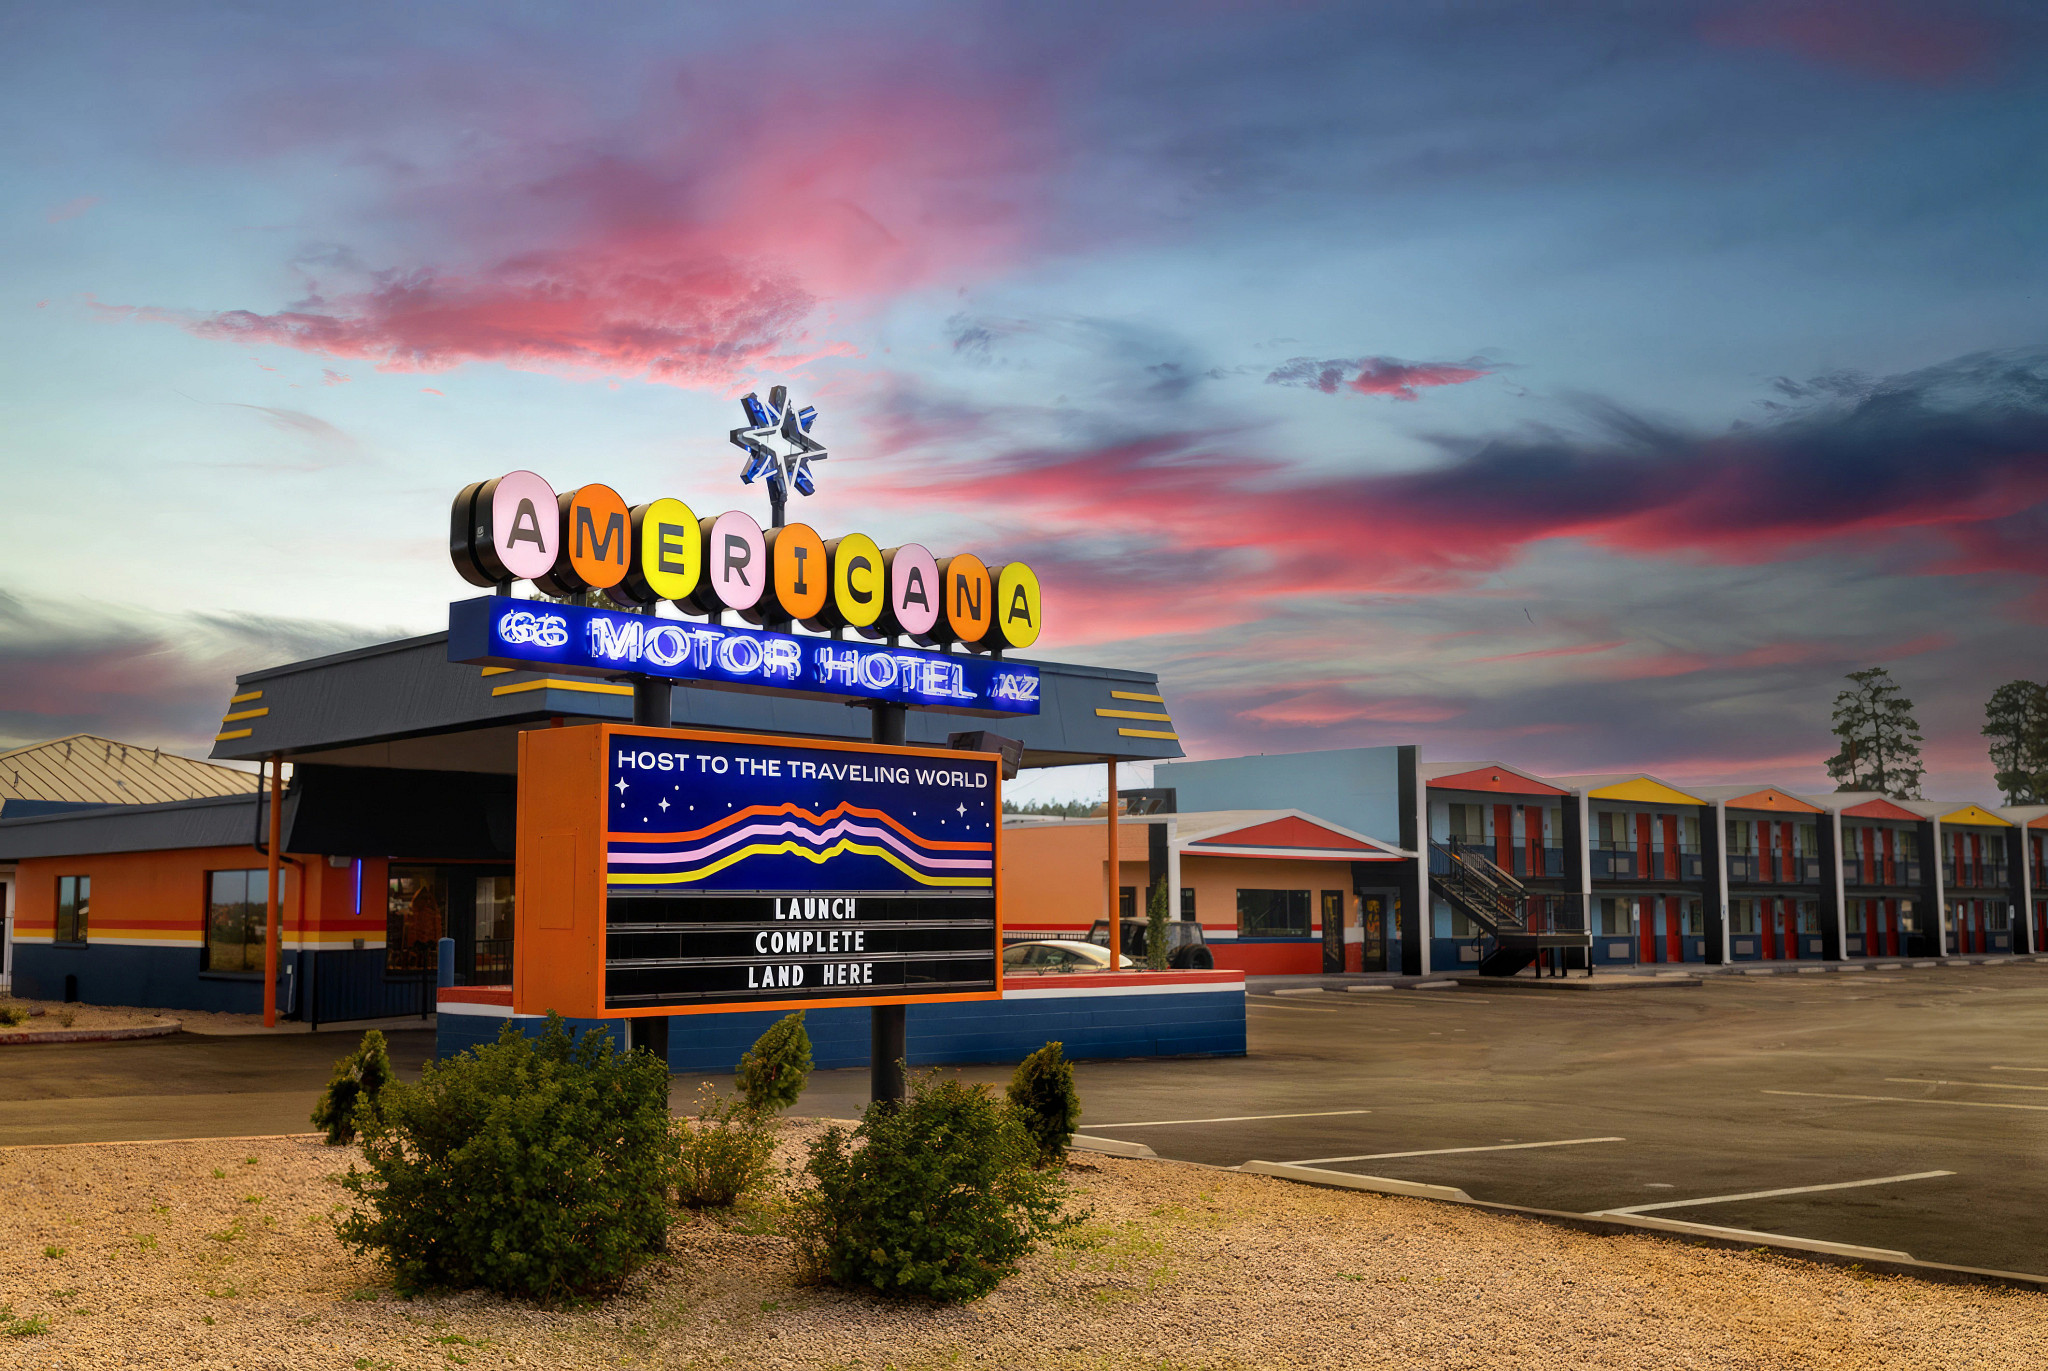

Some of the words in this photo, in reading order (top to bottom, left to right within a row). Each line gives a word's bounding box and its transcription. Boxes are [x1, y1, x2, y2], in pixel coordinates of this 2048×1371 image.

[506, 498, 1032, 628] AMERICANA
[588, 617, 802, 681] MOTOR
[815, 647, 978, 699] HOTEL
[997, 673, 1040, 701] AZ
[618, 750, 690, 772] HOST
[696, 754, 729, 774] TO
[735, 757, 781, 777] THE
[787, 760, 910, 785] TRAVELING
[915, 768, 988, 789] WORLD
[775, 898, 856, 920] LAUNCH
[755, 931, 864, 953] COMPLETE
[748, 965, 804, 988] LAND
[823, 963, 873, 985] HERE
